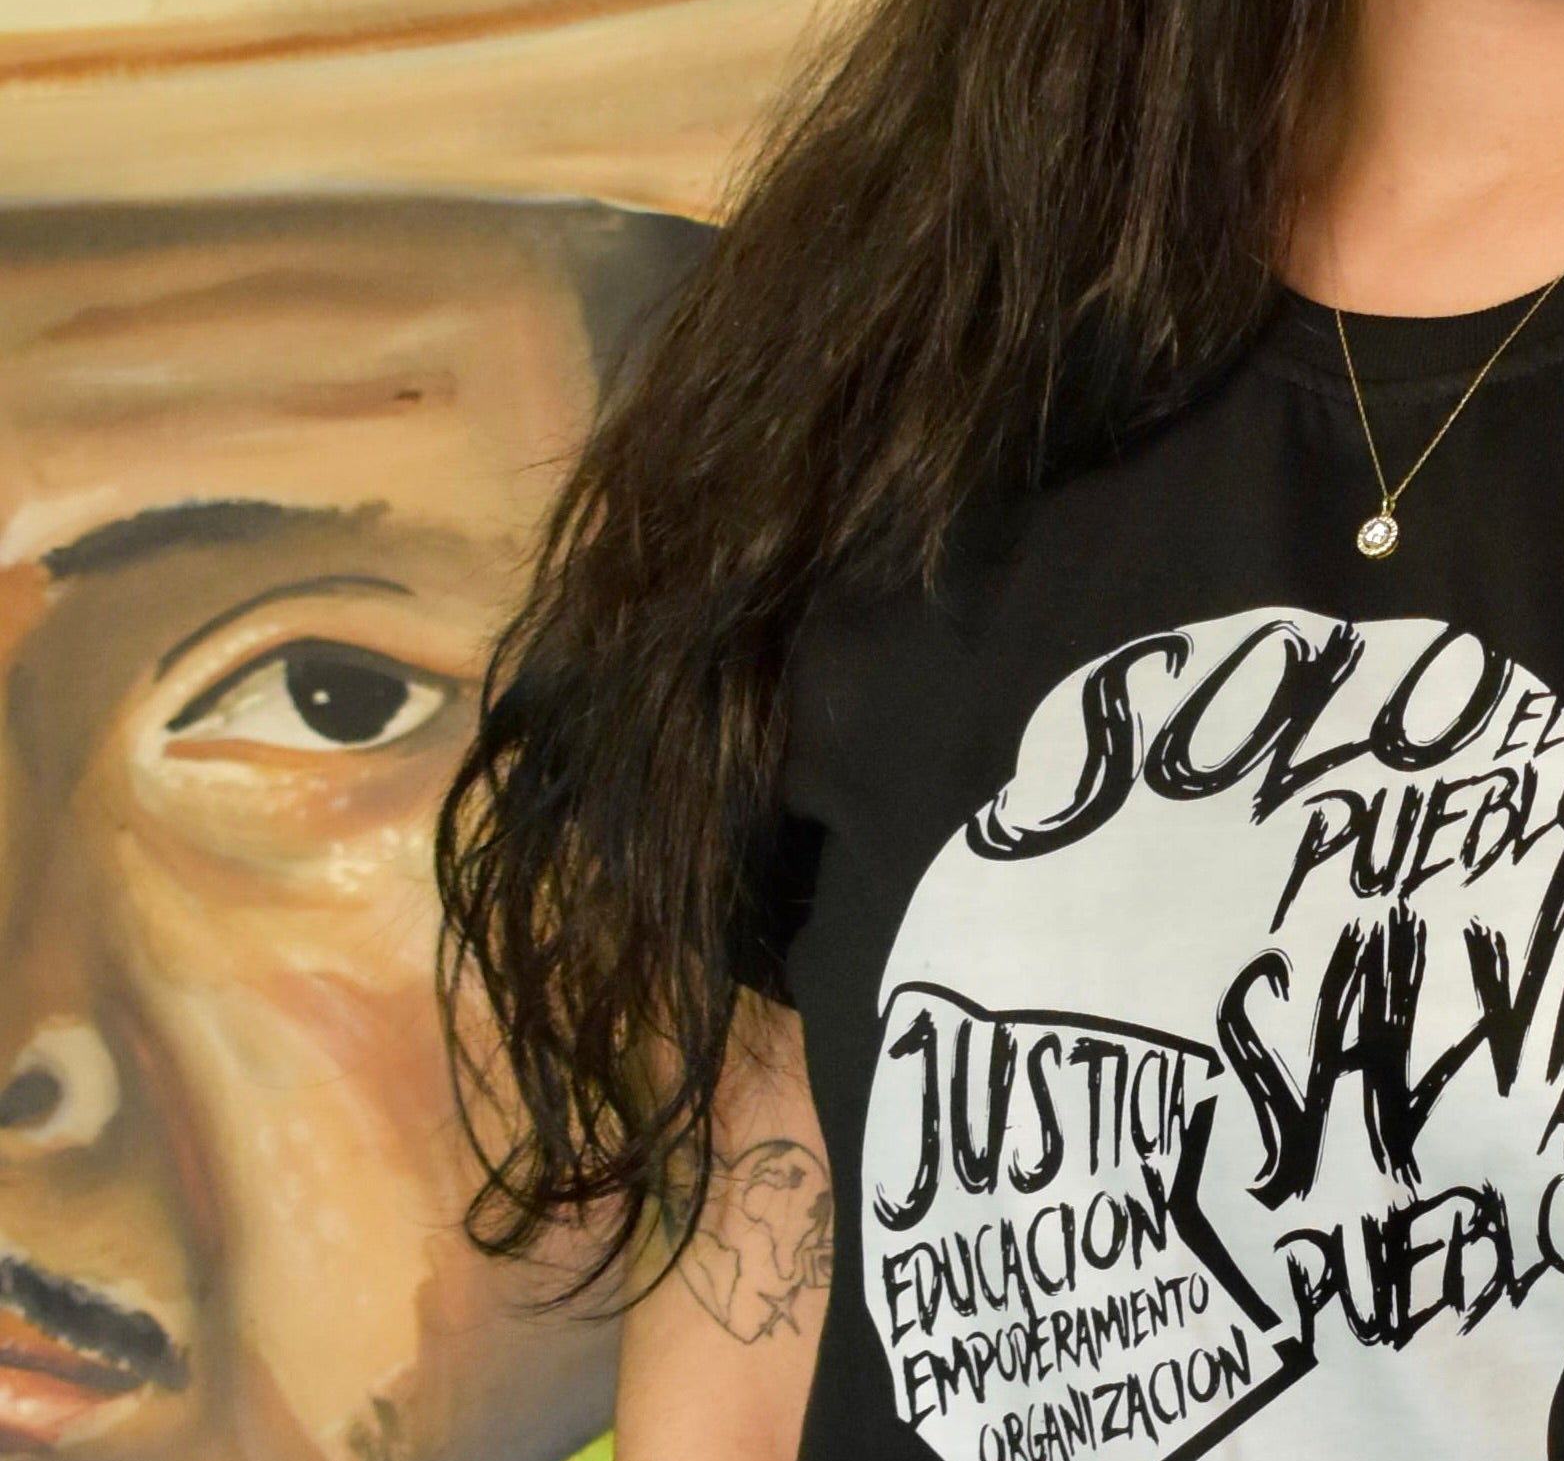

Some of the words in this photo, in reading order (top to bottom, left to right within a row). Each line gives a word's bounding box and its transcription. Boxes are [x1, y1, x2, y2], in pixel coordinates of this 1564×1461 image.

[965, 620, 1516, 861] SOLO
[874, 1008, 1191, 1231] JUSTICIA
[882, 1164, 1170, 1346] EDUCACION
[903, 1272, 1209, 1429] EMPODERAMIENTO
